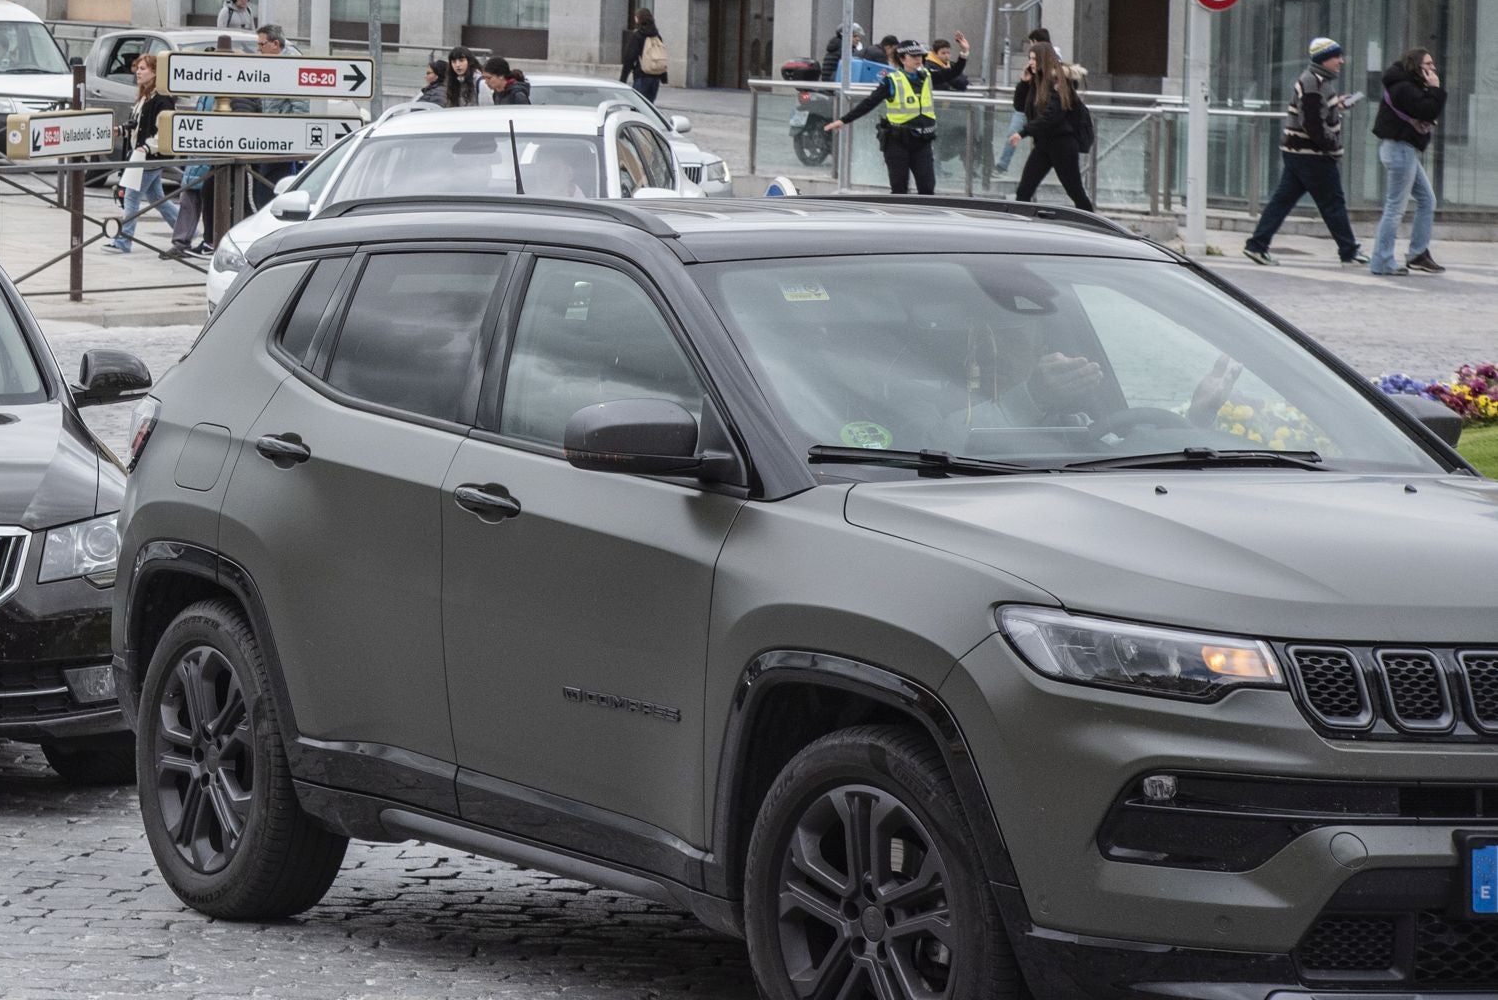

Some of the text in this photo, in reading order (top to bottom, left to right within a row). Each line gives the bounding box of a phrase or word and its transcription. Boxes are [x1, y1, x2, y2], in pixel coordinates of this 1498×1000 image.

[173, 68, 222, 81] Madrid
[236, 70, 271, 83] Avila
[300, 72, 335, 85] SG-20
[178, 119, 204, 131] AVE
[45, 130, 60, 143] SG-20
[63, 128, 92, 142] Valladolid
[96, 126, 111, 140] Soria
[178, 136, 294, 151] Estación Guiomar
[585, 690, 681, 722] COMPASS
[1481, 885, 1491, 899] E
